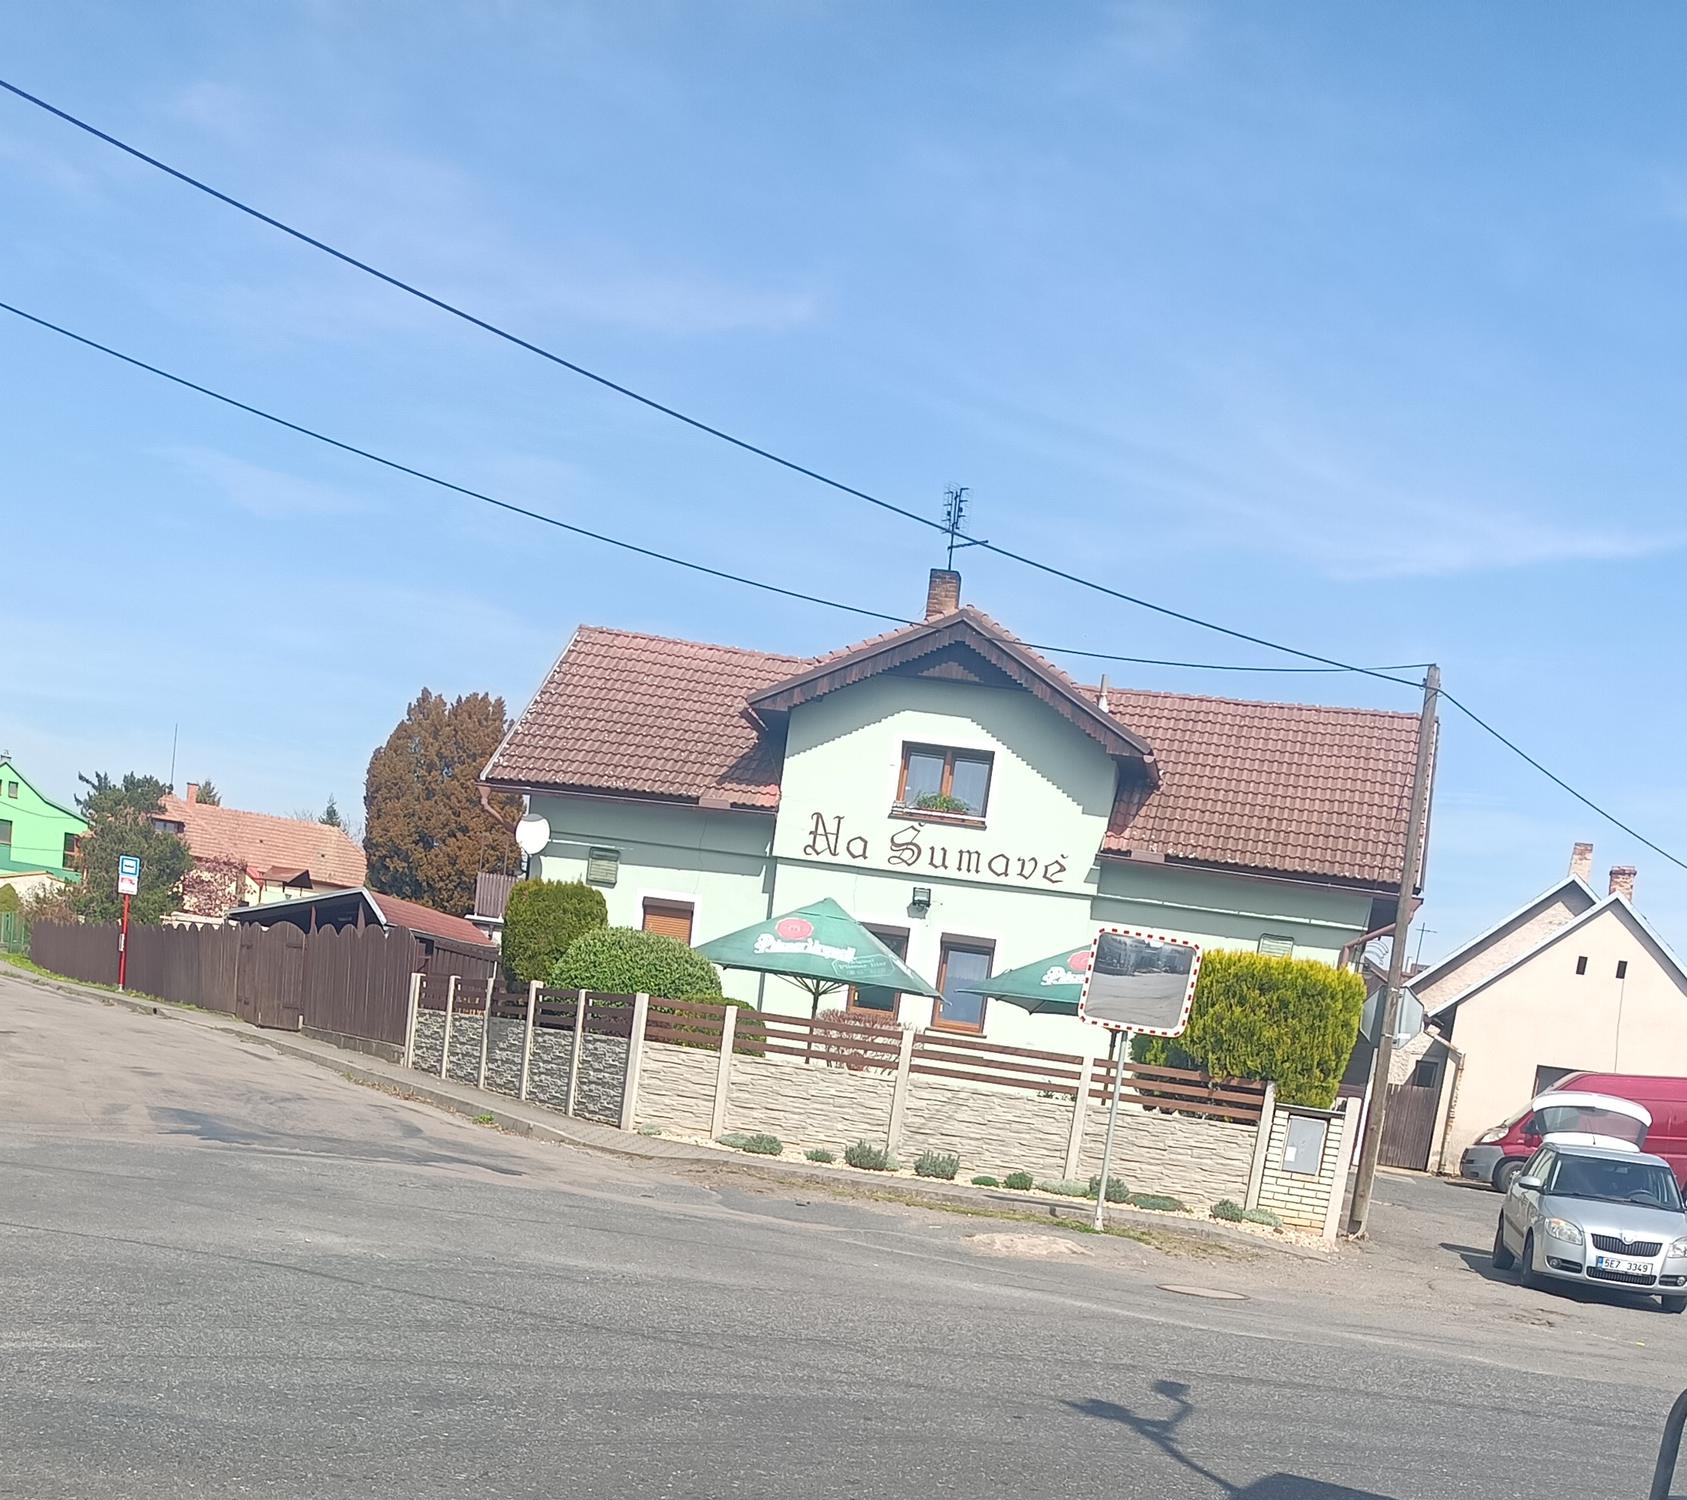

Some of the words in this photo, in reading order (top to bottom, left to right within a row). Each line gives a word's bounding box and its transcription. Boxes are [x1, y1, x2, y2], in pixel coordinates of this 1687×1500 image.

[803, 811, 869, 860] Na
[887, 821, 1069, 884] Šumavě
[1604, 1258, 1621, 1269] 5E7
[1626, 1262, 1649, 1273] 3349
